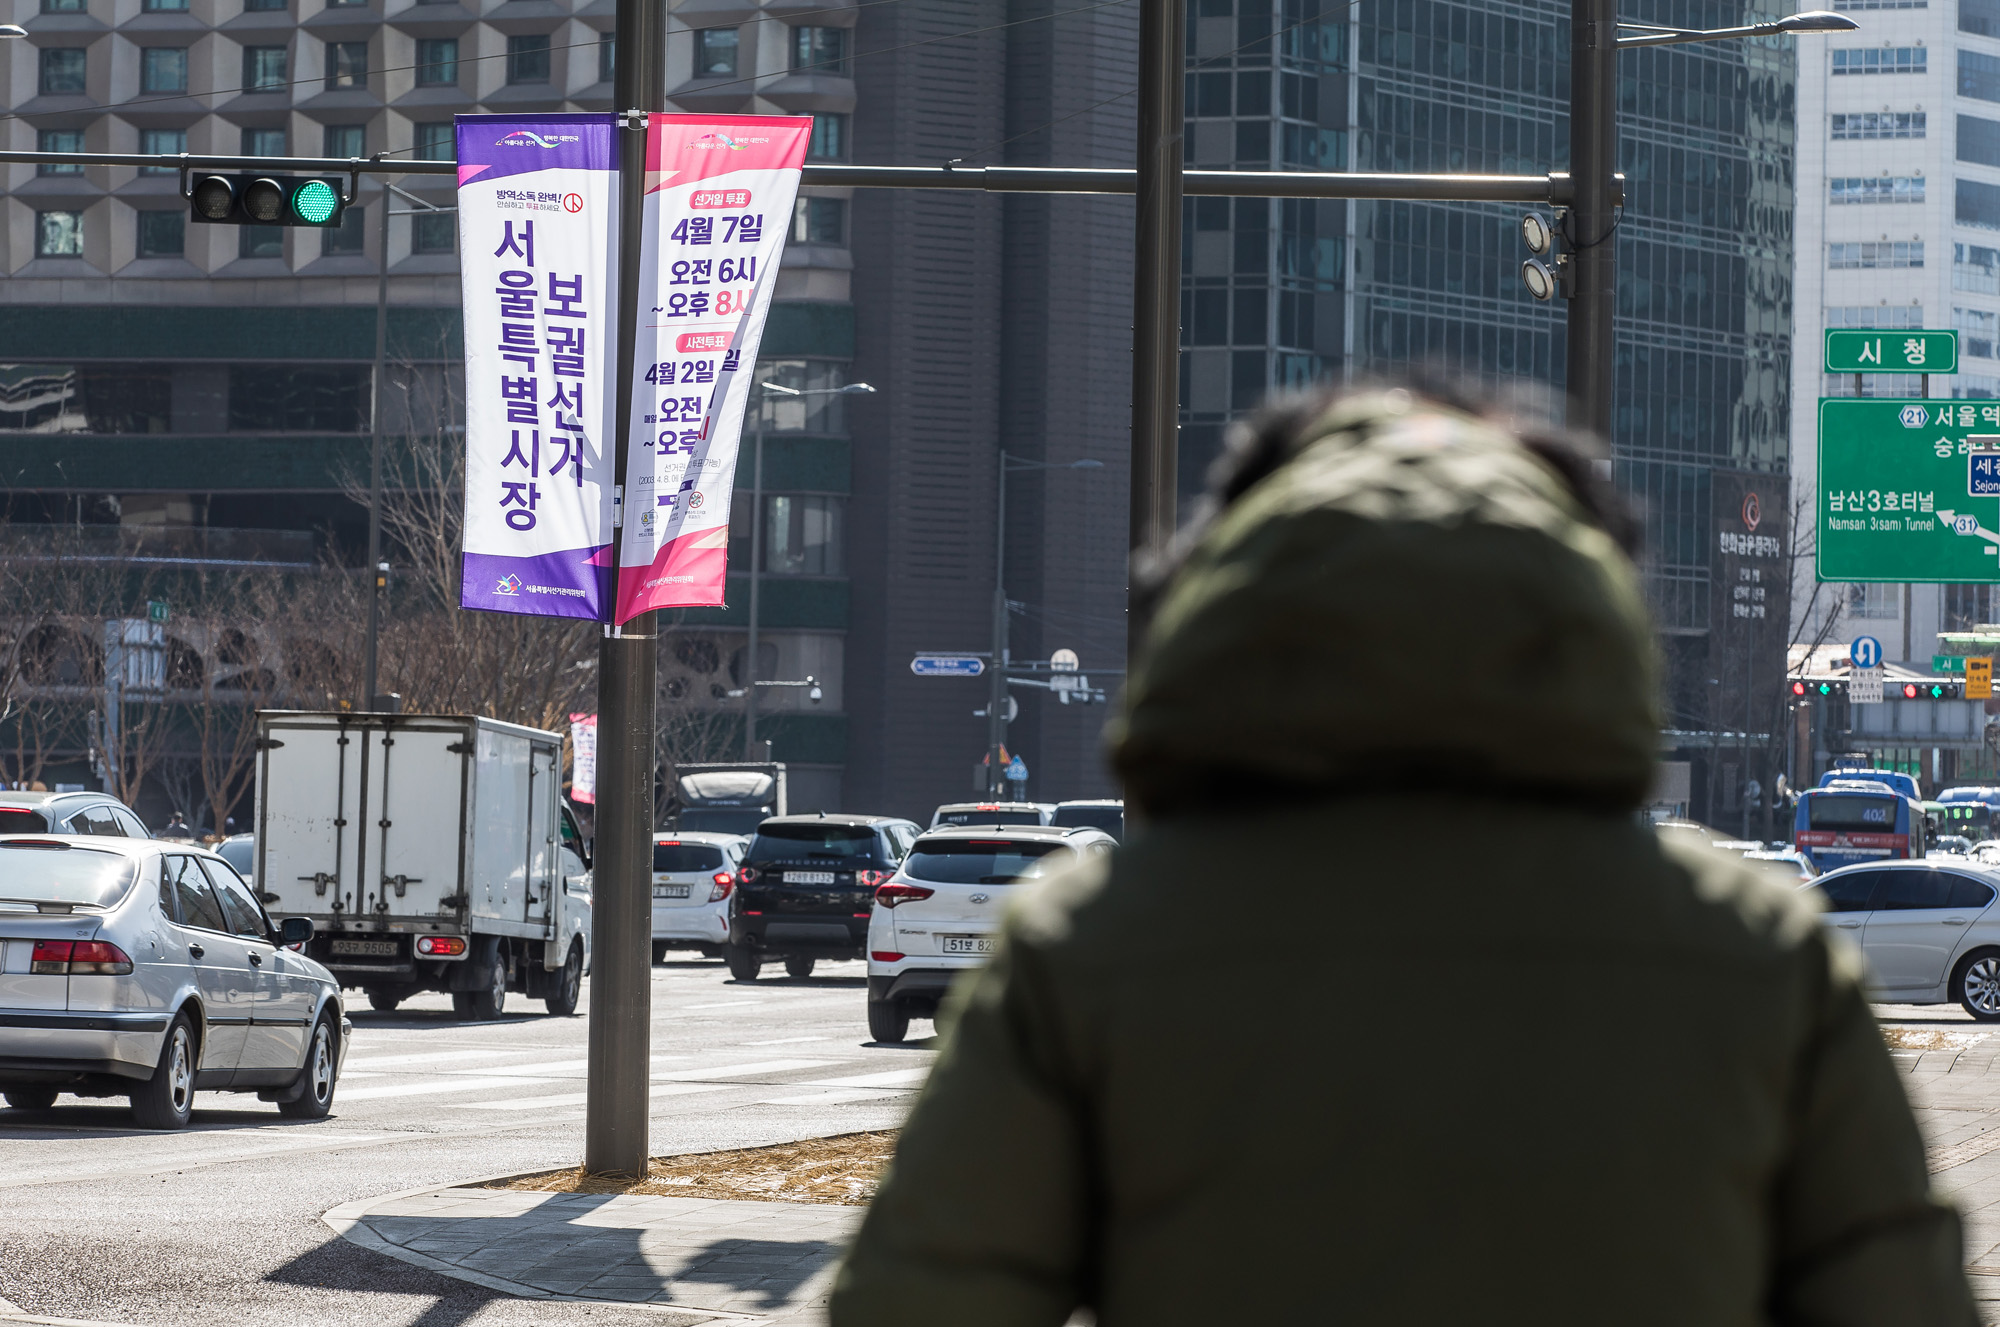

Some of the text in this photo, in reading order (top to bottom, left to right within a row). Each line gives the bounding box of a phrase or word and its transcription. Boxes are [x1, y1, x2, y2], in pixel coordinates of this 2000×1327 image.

[504, 139, 525, 147] 아름다운
[559, 135, 580, 143] 대한민국
[496, 189, 562, 203] 방역소독 완벽!
[694, 192, 746, 206] 선거일 투표
[496, 201, 525, 209] 안심하고
[670, 214, 764, 246] 4월 7일
[669, 256, 757, 285] 오전 6시
[685, 335, 726, 349] 사전투표
[494, 219, 541, 532] 서울특별시장
[543, 271, 587, 488] 보궐선거
[644, 361, 677, 386] 4월
[680, 360, 715, 384] 2일
[659, 396, 702, 423] 오전
[1906, 410, 1922, 424] 21
[1828, 489, 1934, 513] 남산3호터널
[1828, 516, 1935, 531] Namsan 3(sam) Tunnel
[1958, 518, 1973, 531] 31
[524, 584, 586, 599] 서울특별시선거관리위원회
[949, 939, 1000, 952] 51보 829
